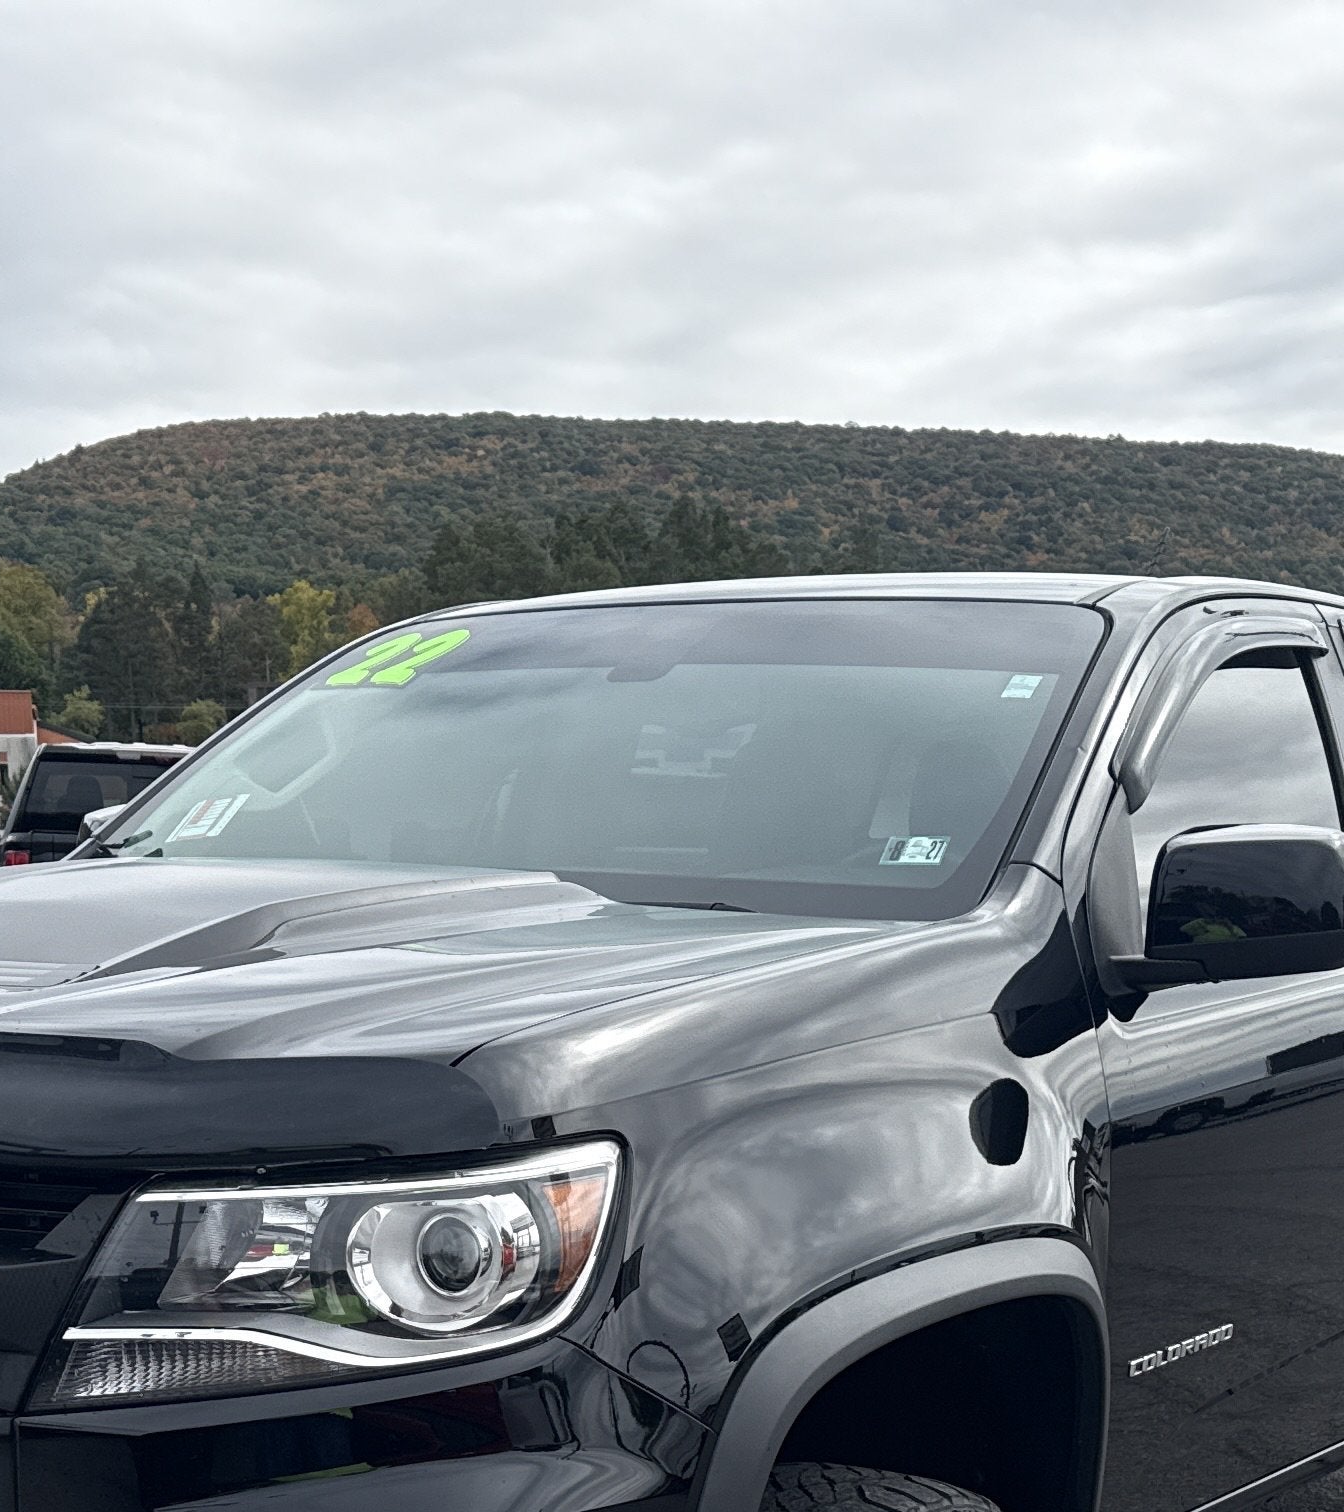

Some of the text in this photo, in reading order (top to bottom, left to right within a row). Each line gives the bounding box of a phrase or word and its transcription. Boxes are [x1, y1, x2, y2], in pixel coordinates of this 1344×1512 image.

[325, 628, 471, 687] 22
[925, 840, 945, 861] 27
[1129, 1323, 1234, 1377] COLORADO
